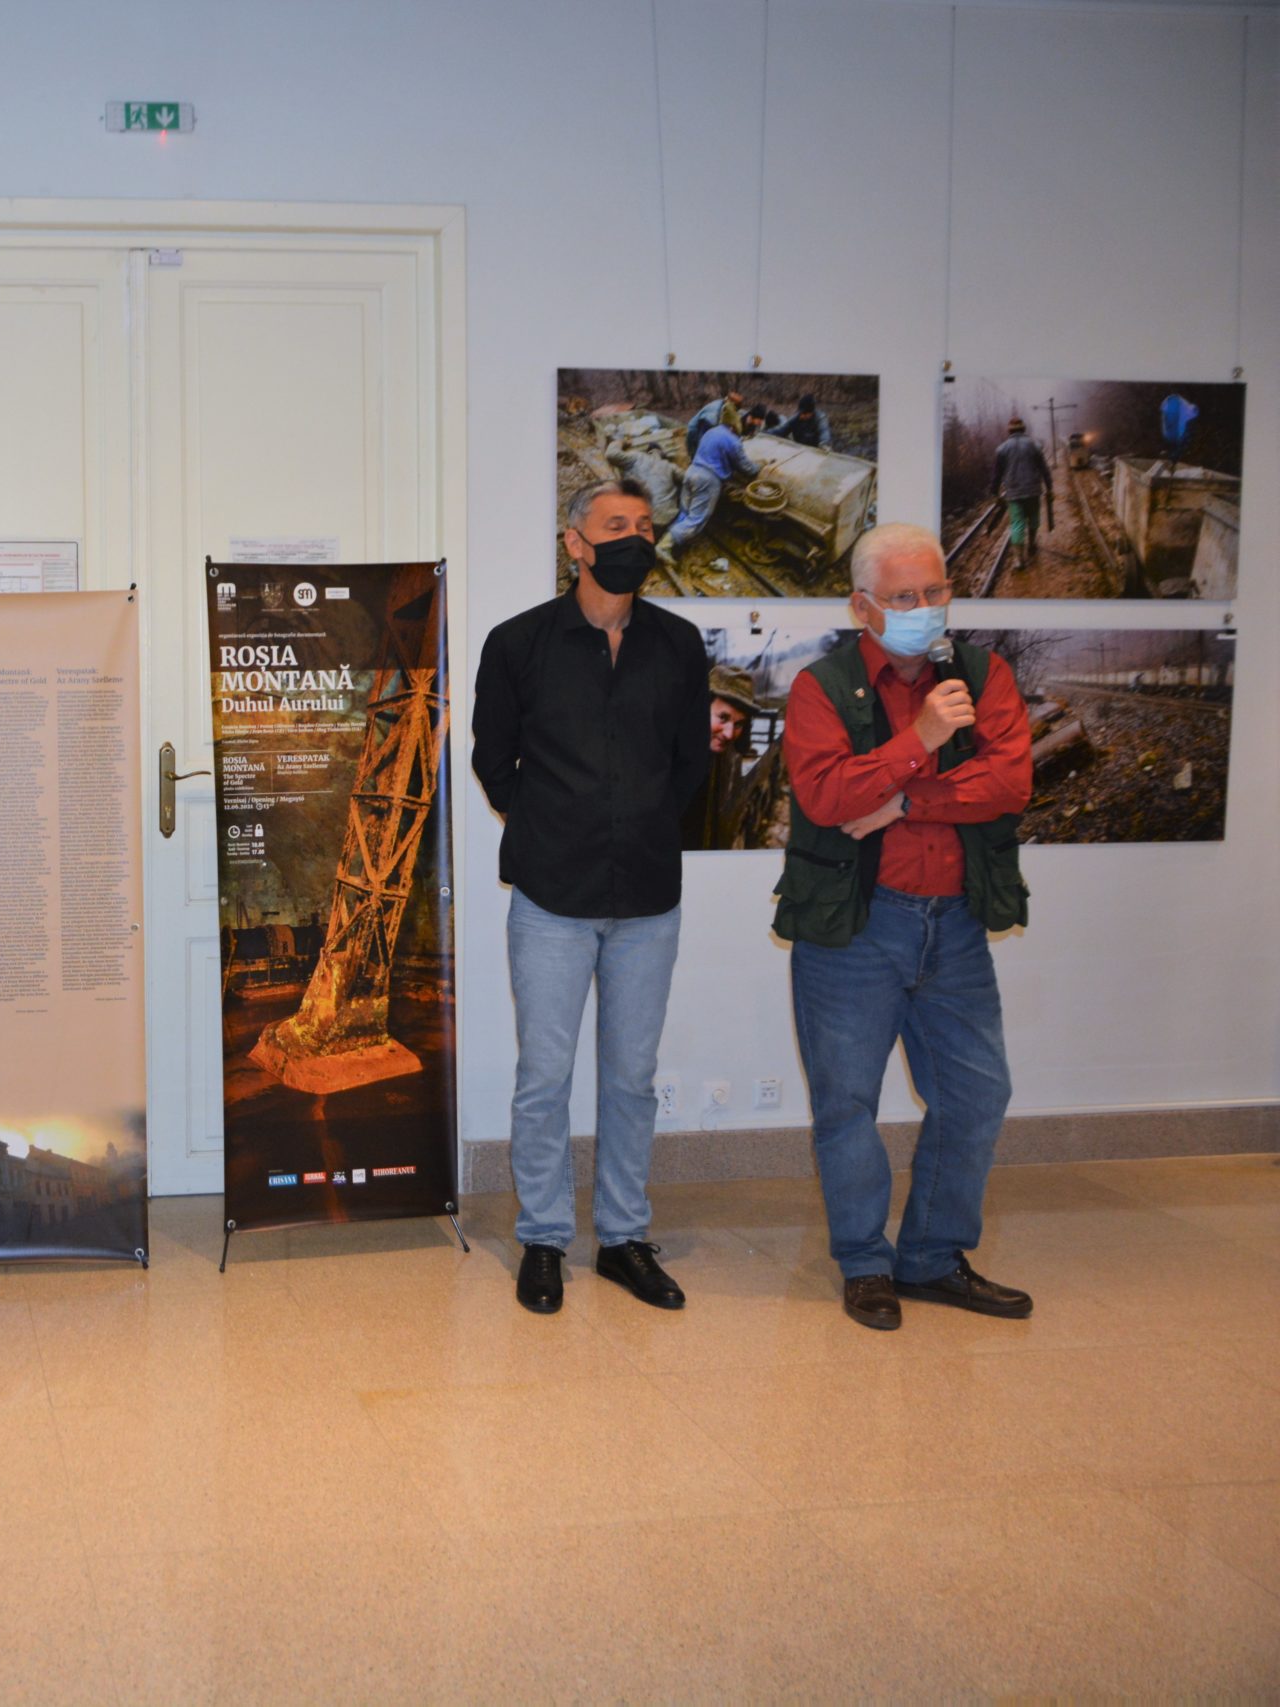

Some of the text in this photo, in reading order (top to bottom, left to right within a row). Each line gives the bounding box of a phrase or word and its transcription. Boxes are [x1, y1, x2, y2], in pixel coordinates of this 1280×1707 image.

[220, 645, 298, 672] ROȘIA
[30, 677, 47, 686] Gold
[221, 664, 355, 692] MONTANĂ
[222, 694, 345, 713] Duhul Aurului
[277, 754, 330, 763] VERESPATAK
[223, 762, 265, 772] MONTANĂ
[235, 773, 256, 781] Spectre
[251, 796, 275, 804] Opening
